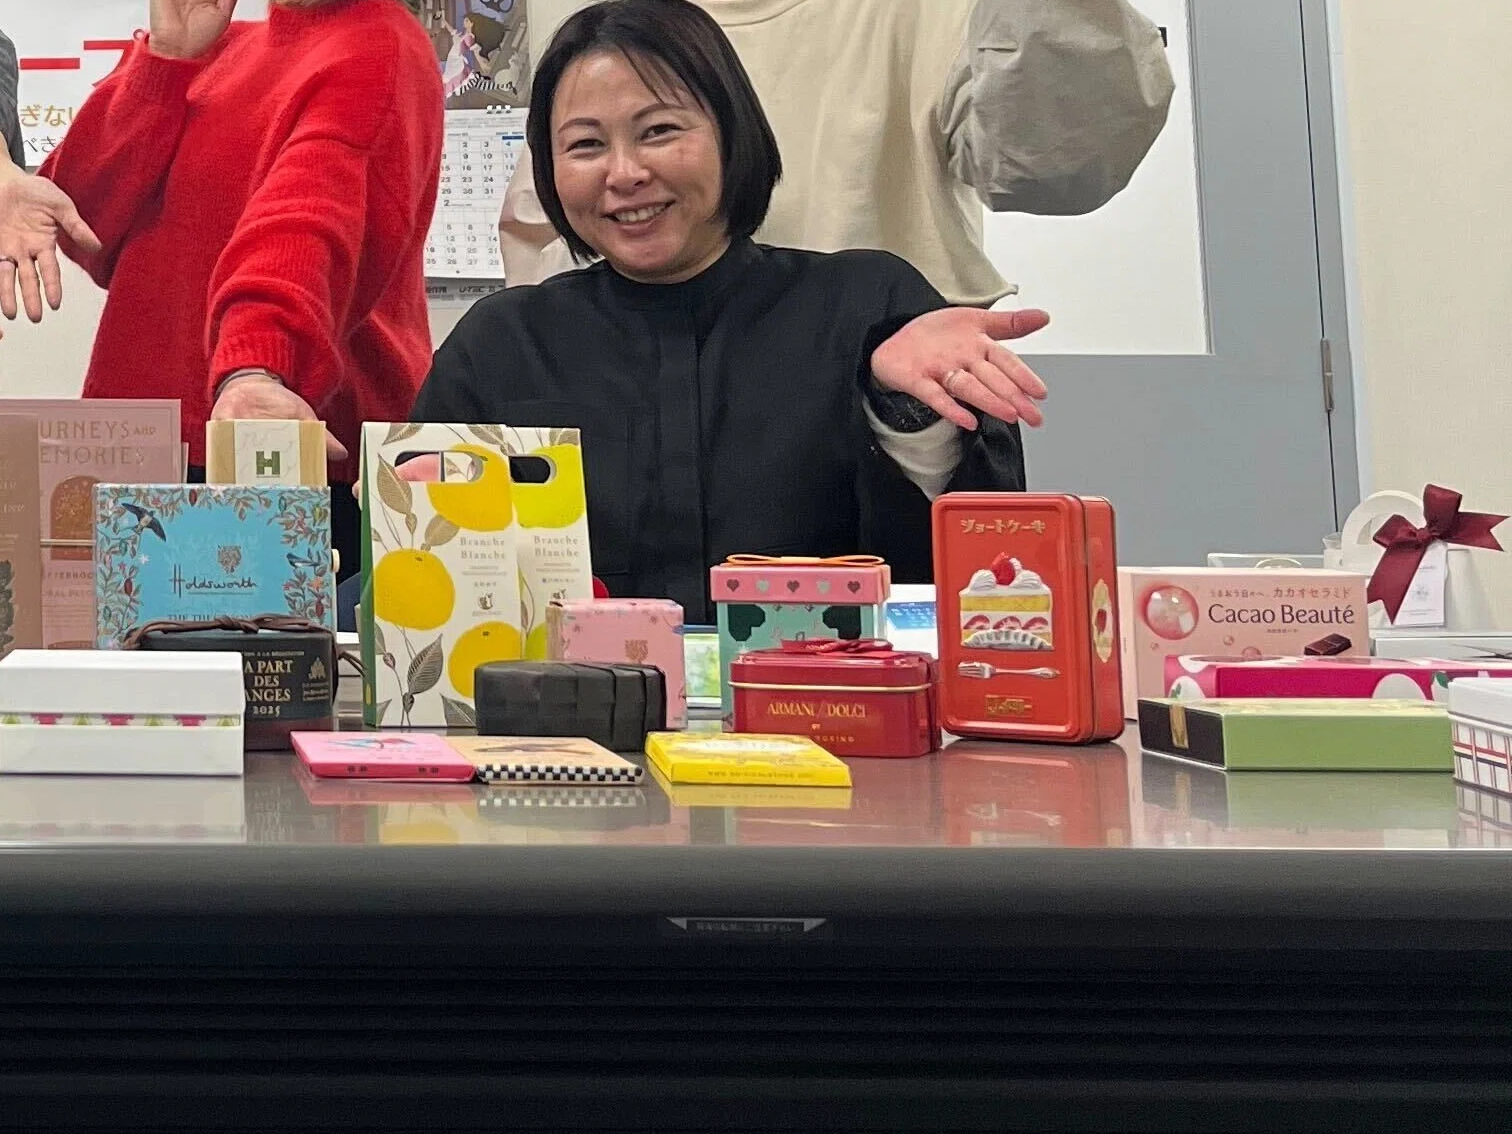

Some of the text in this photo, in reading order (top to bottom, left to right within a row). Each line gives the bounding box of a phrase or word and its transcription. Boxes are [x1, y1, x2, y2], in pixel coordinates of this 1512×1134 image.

[39, 420, 129, 439] URNEYS
[39, 446, 145, 465] EMORIES
[255, 450, 281, 476] H
[960, 519, 1046, 534] ショートケーキ
[169, 564, 257, 599] Holdsworth
[1208, 603, 1355, 624] Cacao Beauté
[257, 659, 294, 674] PART
[254, 675, 280, 688] DES
[252, 705, 281, 718] 2025
